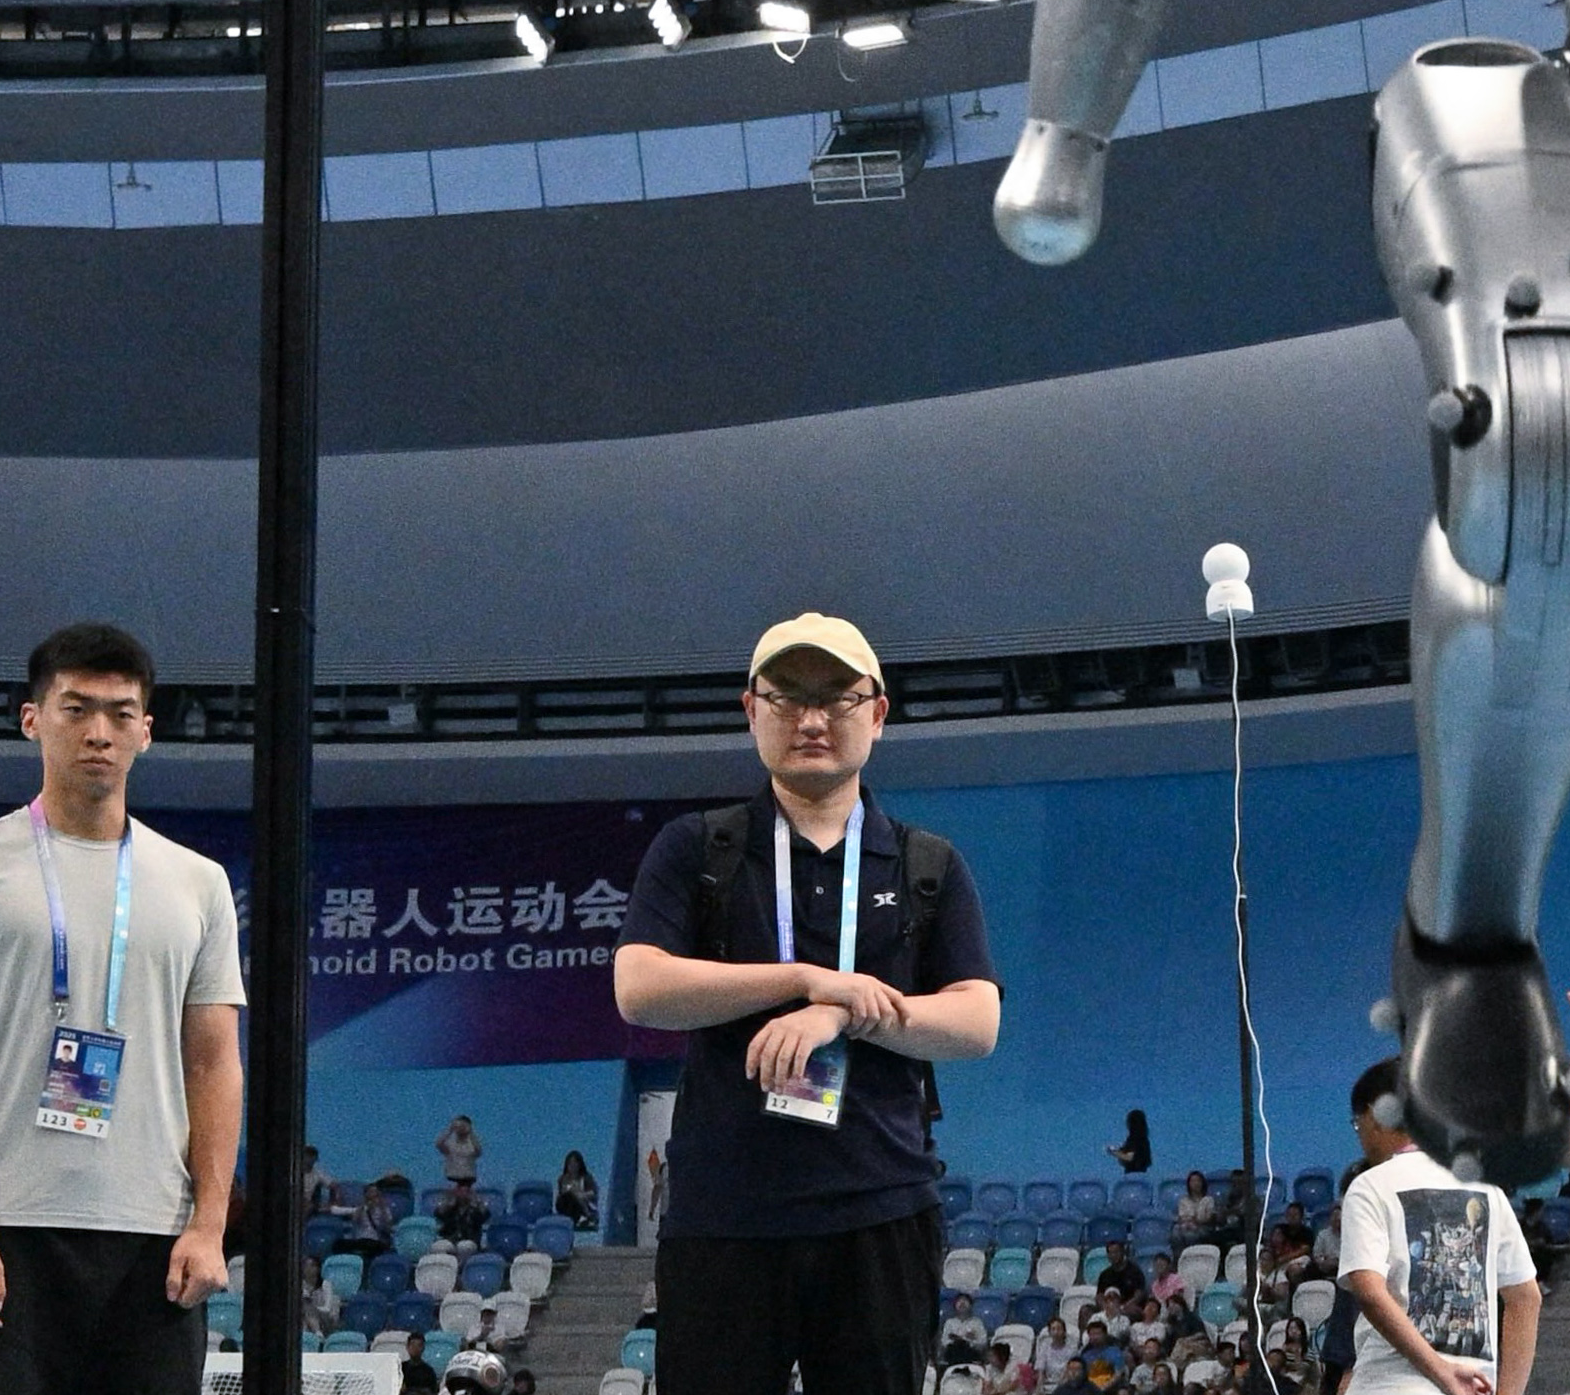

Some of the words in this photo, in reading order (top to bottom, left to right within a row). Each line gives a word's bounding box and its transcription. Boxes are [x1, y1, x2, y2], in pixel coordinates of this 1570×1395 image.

[308, 878, 629, 939] 器人运动会
[388, 944, 495, 974] Robot
